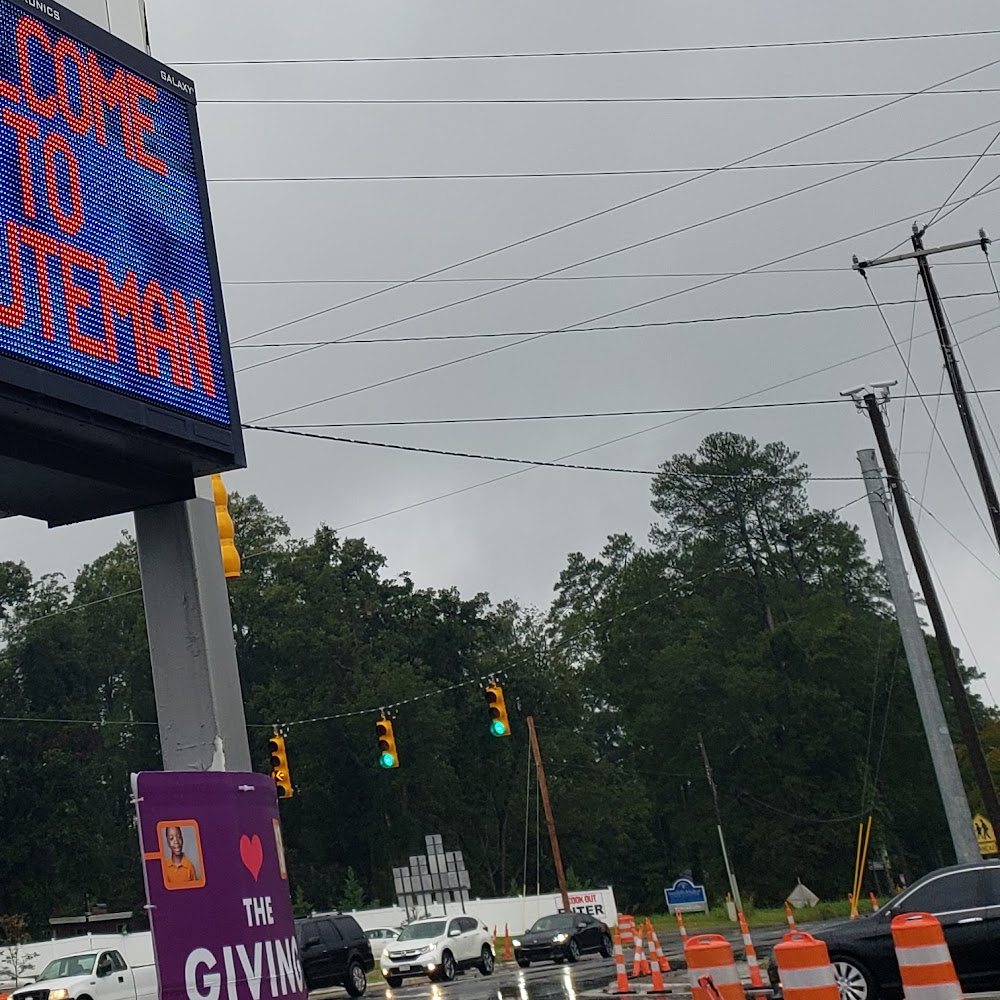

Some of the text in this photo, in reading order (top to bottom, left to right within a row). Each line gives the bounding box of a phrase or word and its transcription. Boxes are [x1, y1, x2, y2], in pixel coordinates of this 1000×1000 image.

[160, 70, 195, 95] GALAXY
[3, 108, 84, 237] TO
[242, 896, 275, 927] THE
[184, 935, 303, 1000] GIVING
